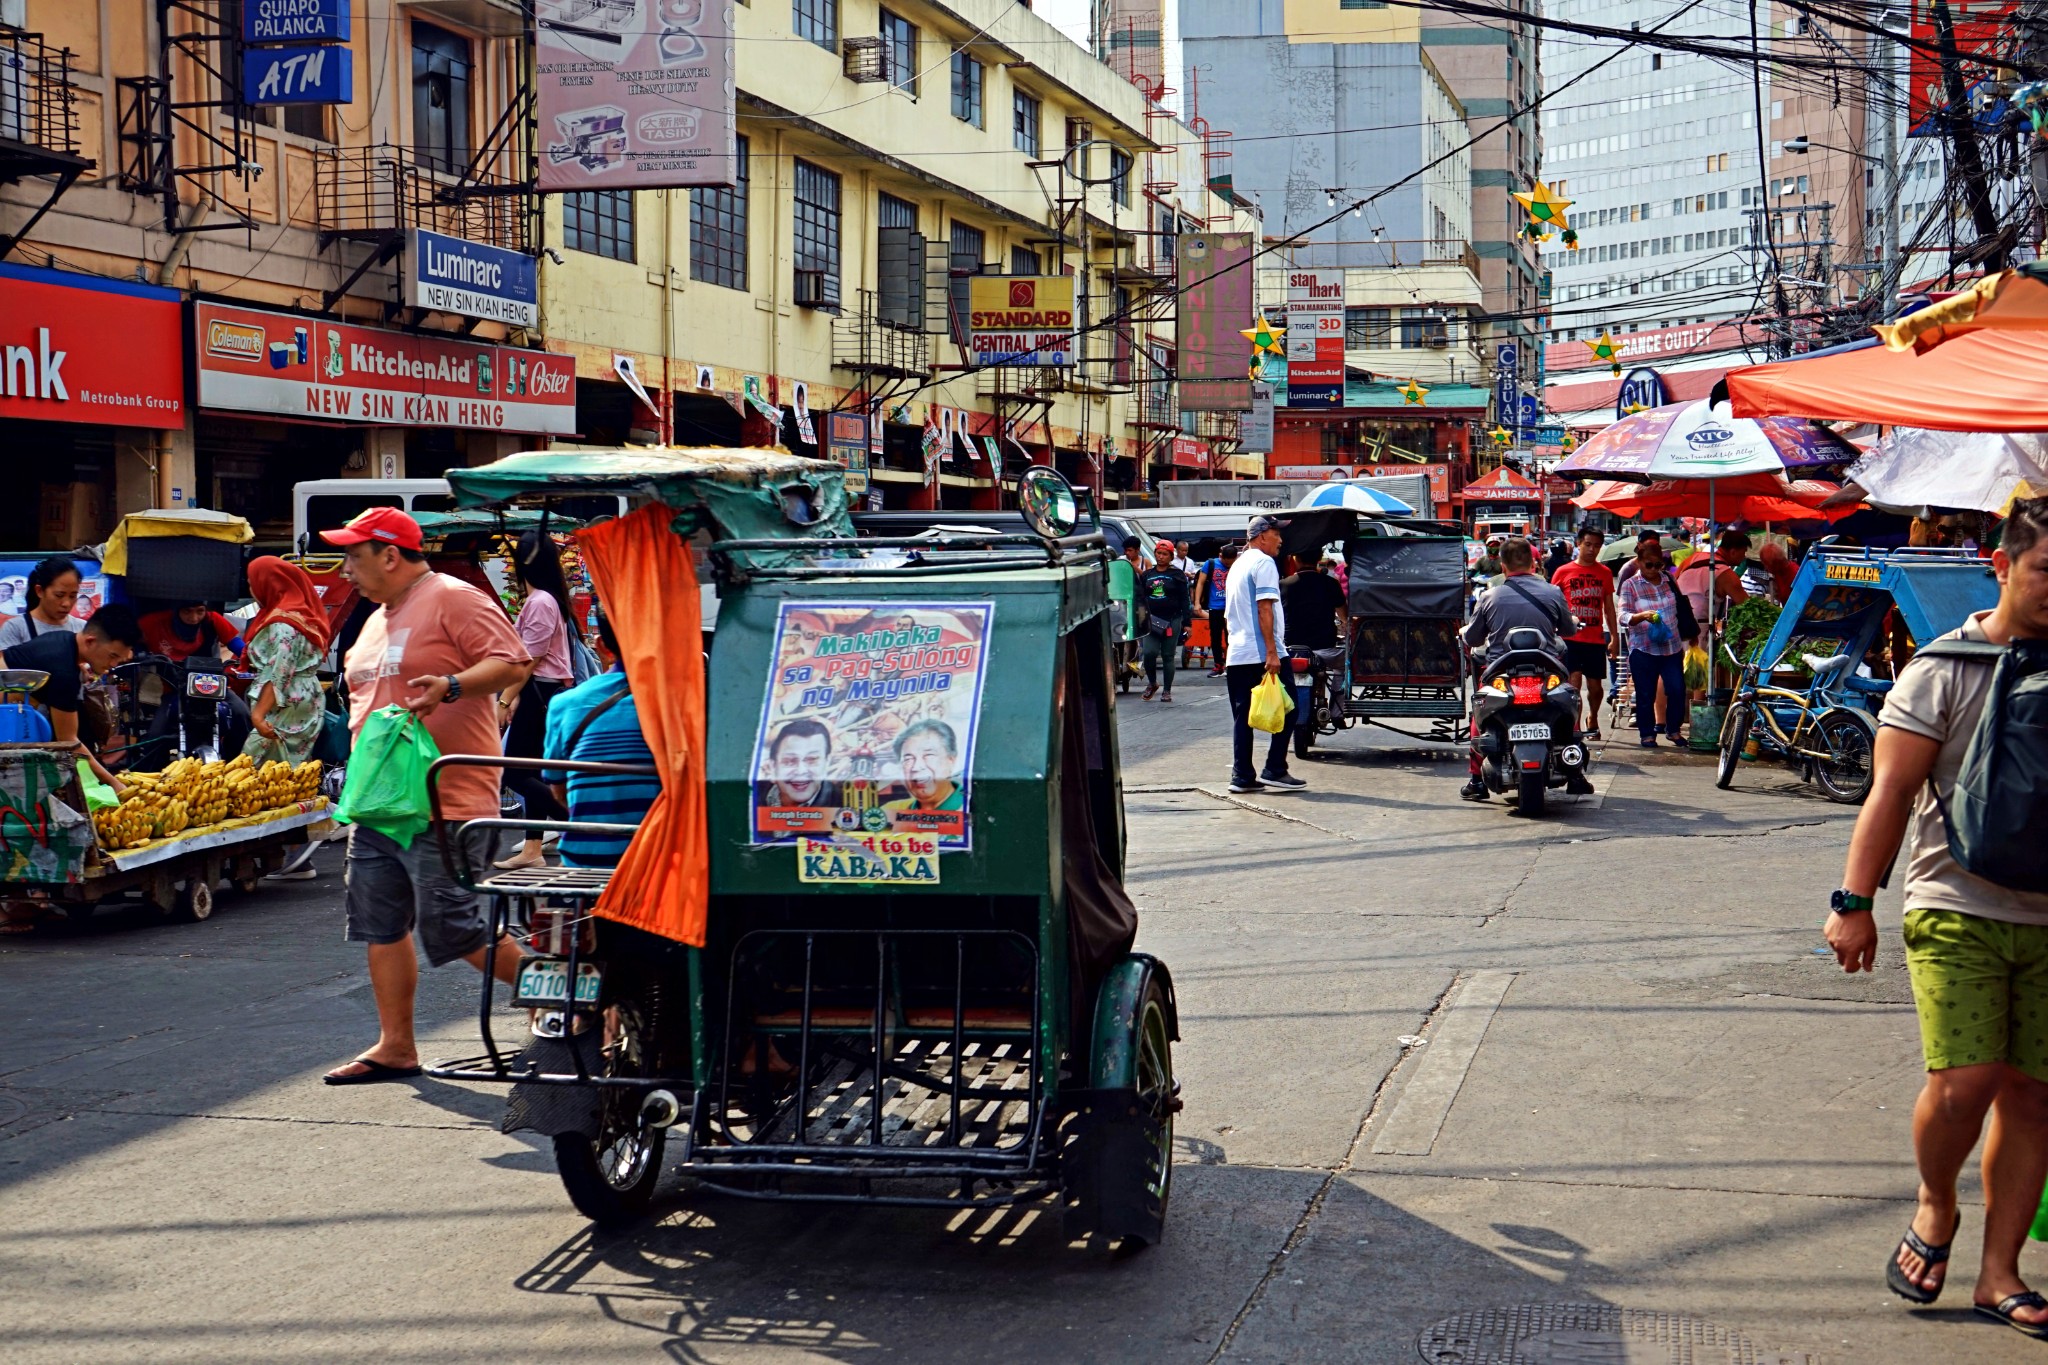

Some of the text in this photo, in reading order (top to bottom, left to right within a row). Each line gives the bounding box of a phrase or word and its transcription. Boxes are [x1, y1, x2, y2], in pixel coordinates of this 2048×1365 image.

[260, 0, 320, 19] QUIAPO
[254, 17, 326, 36] PALANCA
[259, 49, 325, 99] ATM
[555, 63, 569, 73] OR
[570, 61, 615, 73] ELECTRIC
[617, 67, 710, 83] FINE ICE SHAVER
[560, 77, 594, 87] FRYERS
[628, 82, 699, 95] HEAVY DUTY
[643, 116, 689, 129] 大新牌
[645, 128, 692, 140] TASIN
[637, 160, 697, 172] MEAT MINCER
[427, 240, 502, 289] Luminarc
[428, 287, 528, 323] NEW SIN KIAN HENG
[1290, 303, 1342, 312] STAN MARKETING
[971, 310, 1072, 327] STANDARD
[1186, 269, 1206, 375] UNION
[1318, 318, 1341, 331] 3D
[211, 325, 252, 352] Coleman
[972, 333, 1071, 353] CENTRAL HOME
[1664, 327, 1712, 350] OUTLET
[0, 327, 70, 401] nk
[350, 343, 471, 384] KitchenAid
[1290, 369, 1341, 377] KitchenAid
[530, 361, 570, 396] Oster
[80, 390, 179, 412] Metrobank Group
[1288, 391, 1330, 401] Luminarc
[306, 387, 504, 427] NEW SIN KIAN HENG
[1691, 430, 1731, 442] ATC
[1719, 450, 1734, 458] Life
[1484, 489, 1541, 499] JAMISOLA
[1256, 500, 1283, 509] CORP.
[814, 625, 942, 658] Makibaka
[783, 645, 973, 685] sa Pag-Sulong
[801, 670, 952, 708] ng Maynila
[771, 810, 823, 820] Joseph Estrada
[880, 838, 903, 854] to
[906, 837, 934, 854] be
[804, 856, 937, 879] KABAKA
[520, 973, 566, 997] 5010
